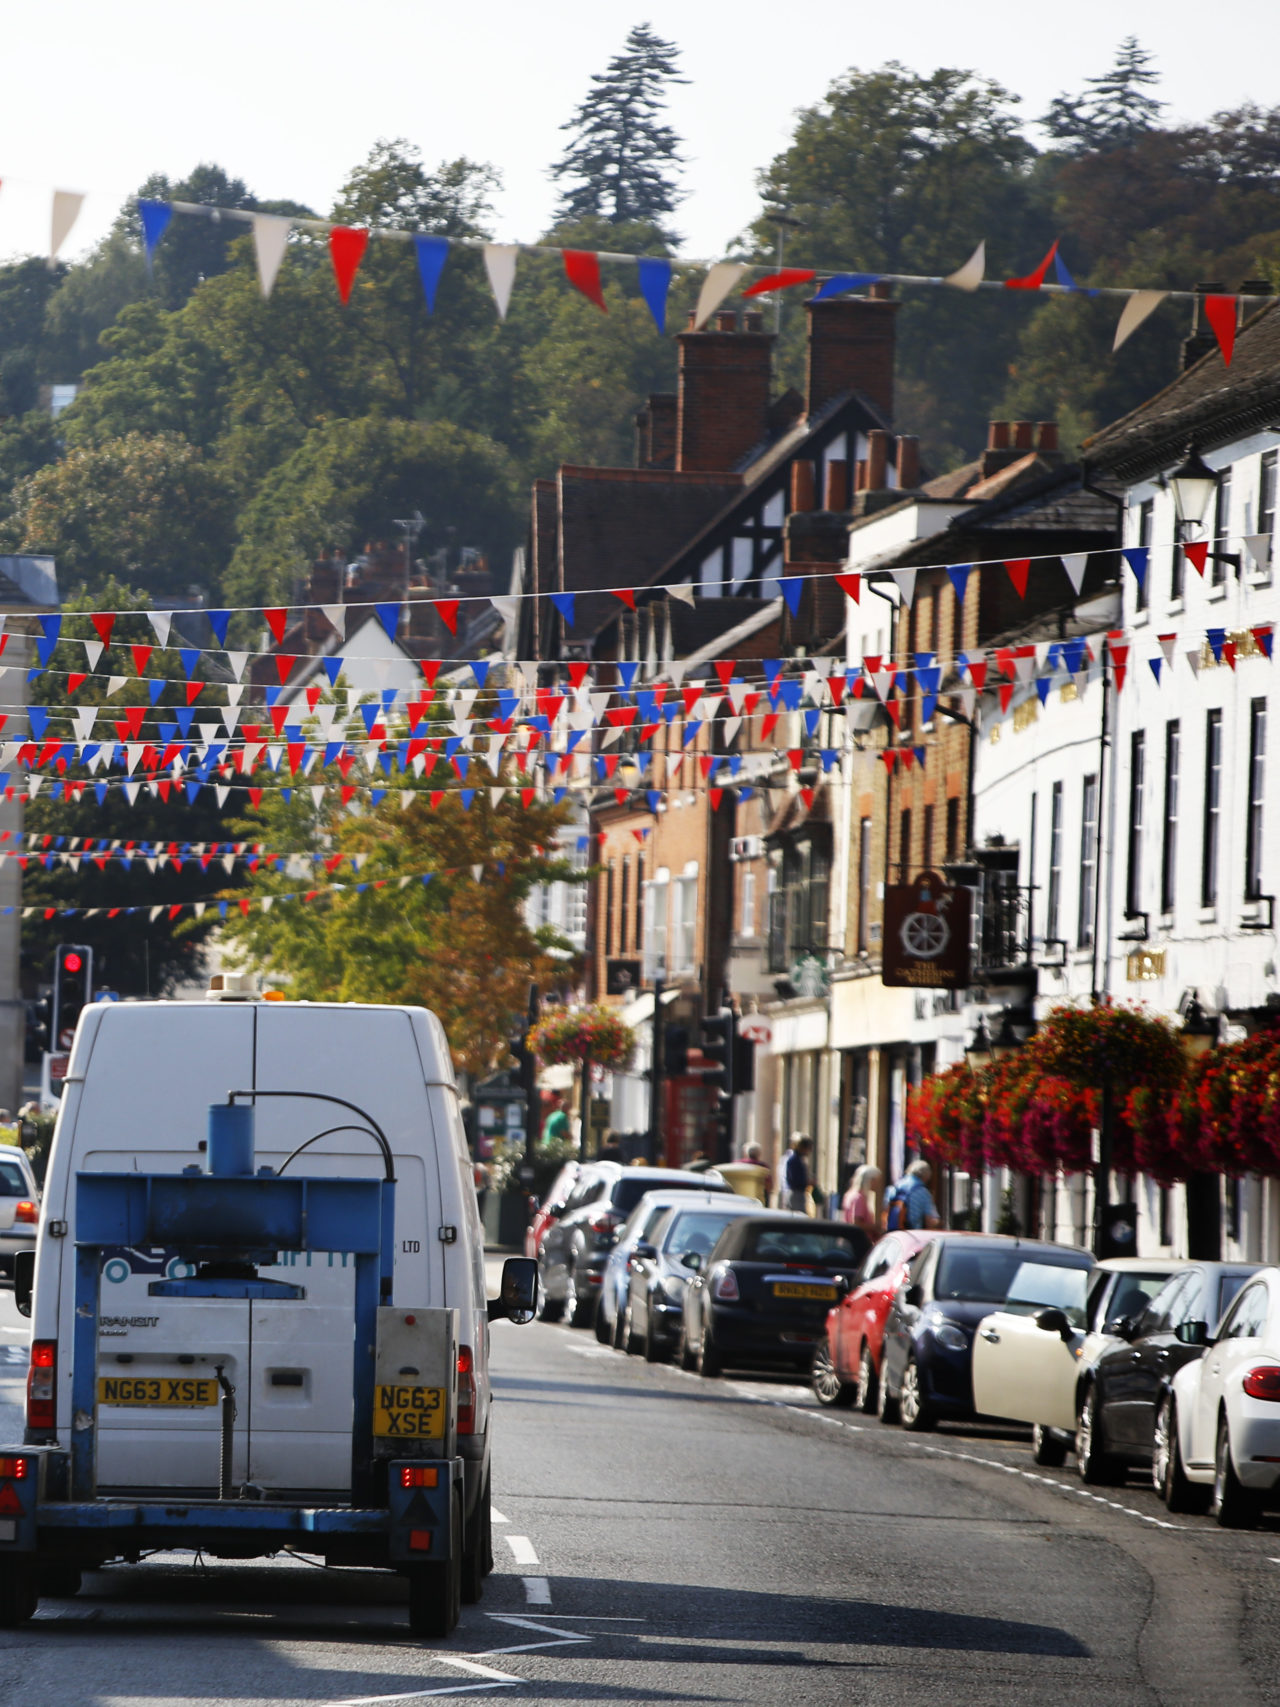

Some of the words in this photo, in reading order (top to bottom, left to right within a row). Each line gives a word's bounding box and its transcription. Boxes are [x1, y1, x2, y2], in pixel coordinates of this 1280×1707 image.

[403, 1240, 420, 1253] LTD
[105, 1381, 161, 1400] NG63
[168, 1381, 209, 1401] XSE
[381, 1386, 440, 1410] NG63
[387, 1412, 432, 1434] XSE
